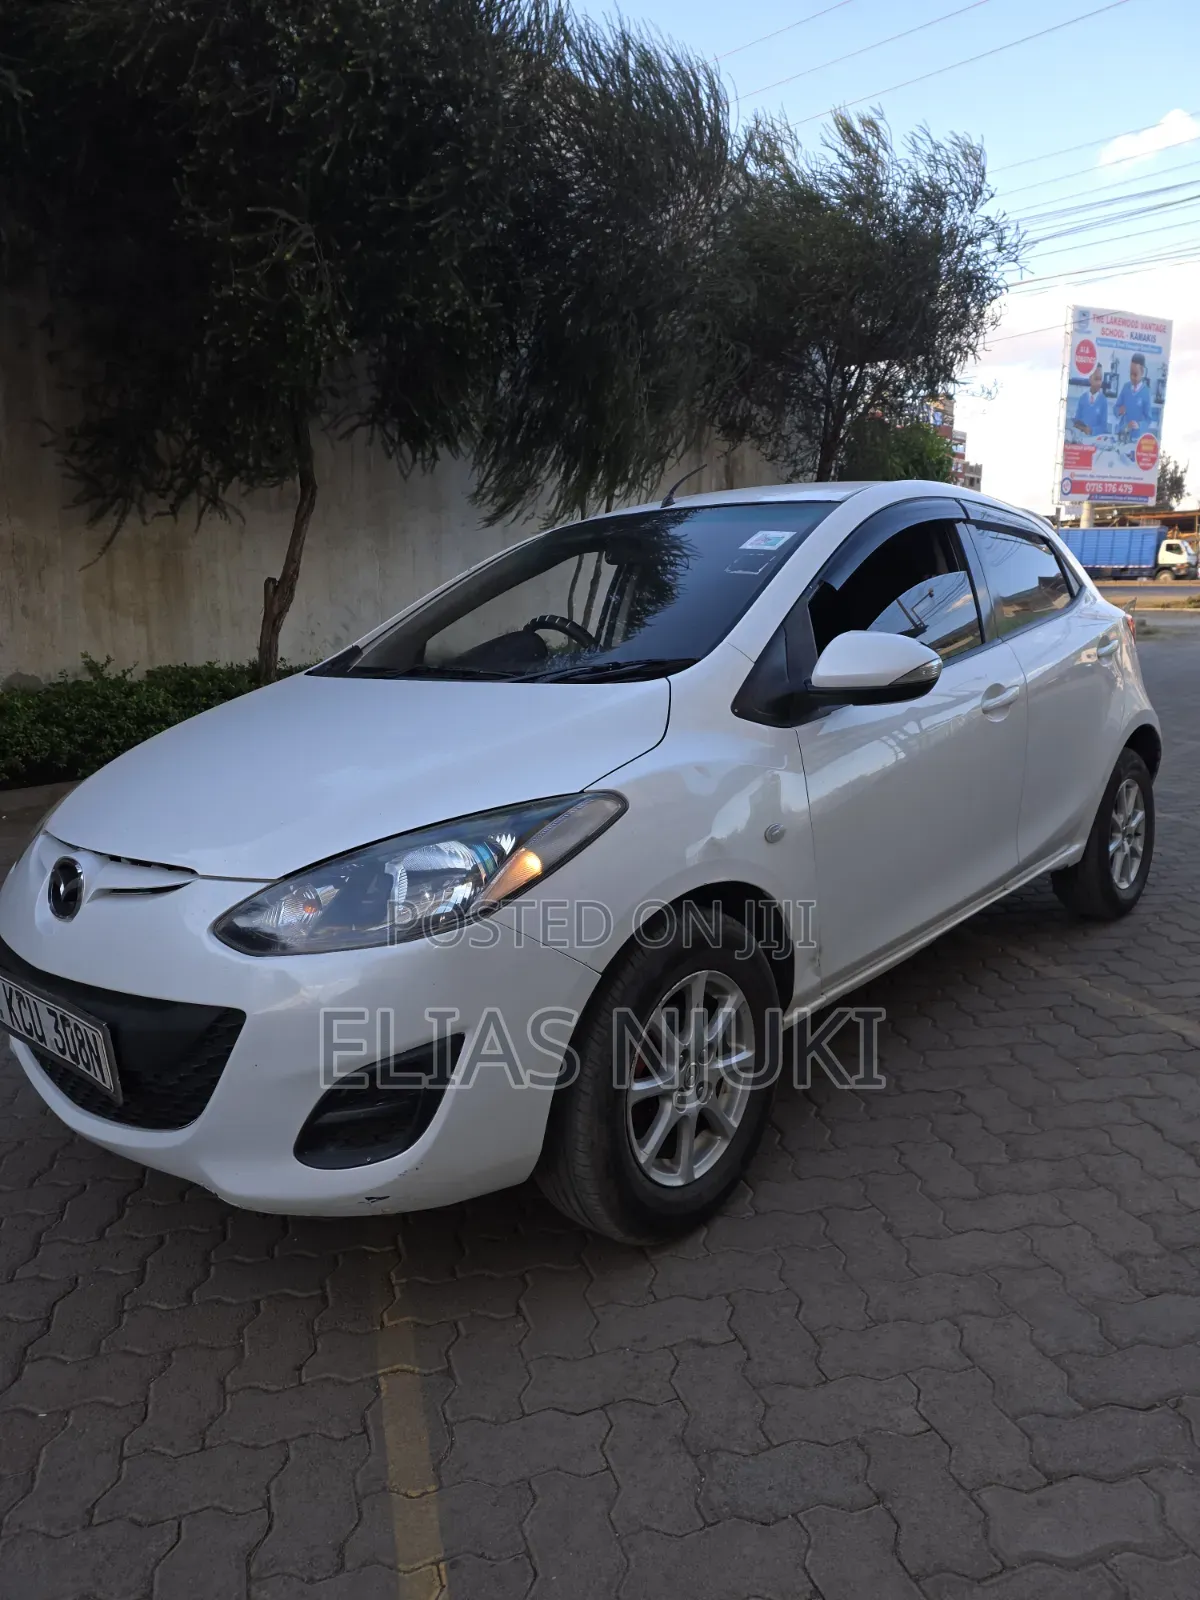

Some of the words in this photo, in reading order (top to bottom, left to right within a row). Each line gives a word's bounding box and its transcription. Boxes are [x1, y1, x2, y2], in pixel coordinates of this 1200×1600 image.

[1092, 314, 1104, 324] THE
[1106, 316, 1138, 329] LAKEWOOD
[1140, 321, 1167, 333] VANTAGE
[1101, 327, 1125, 339] SCHOOL
[1129, 331, 1157, 343] KAMAKIS
[1085, 482, 1103, 492] 0715
[1104, 483, 1117, 493] 176
[1118, 484, 1133, 494] 479
[2, 983, 48, 1047] KCU
[46, 1007, 106, 1084] 308N
